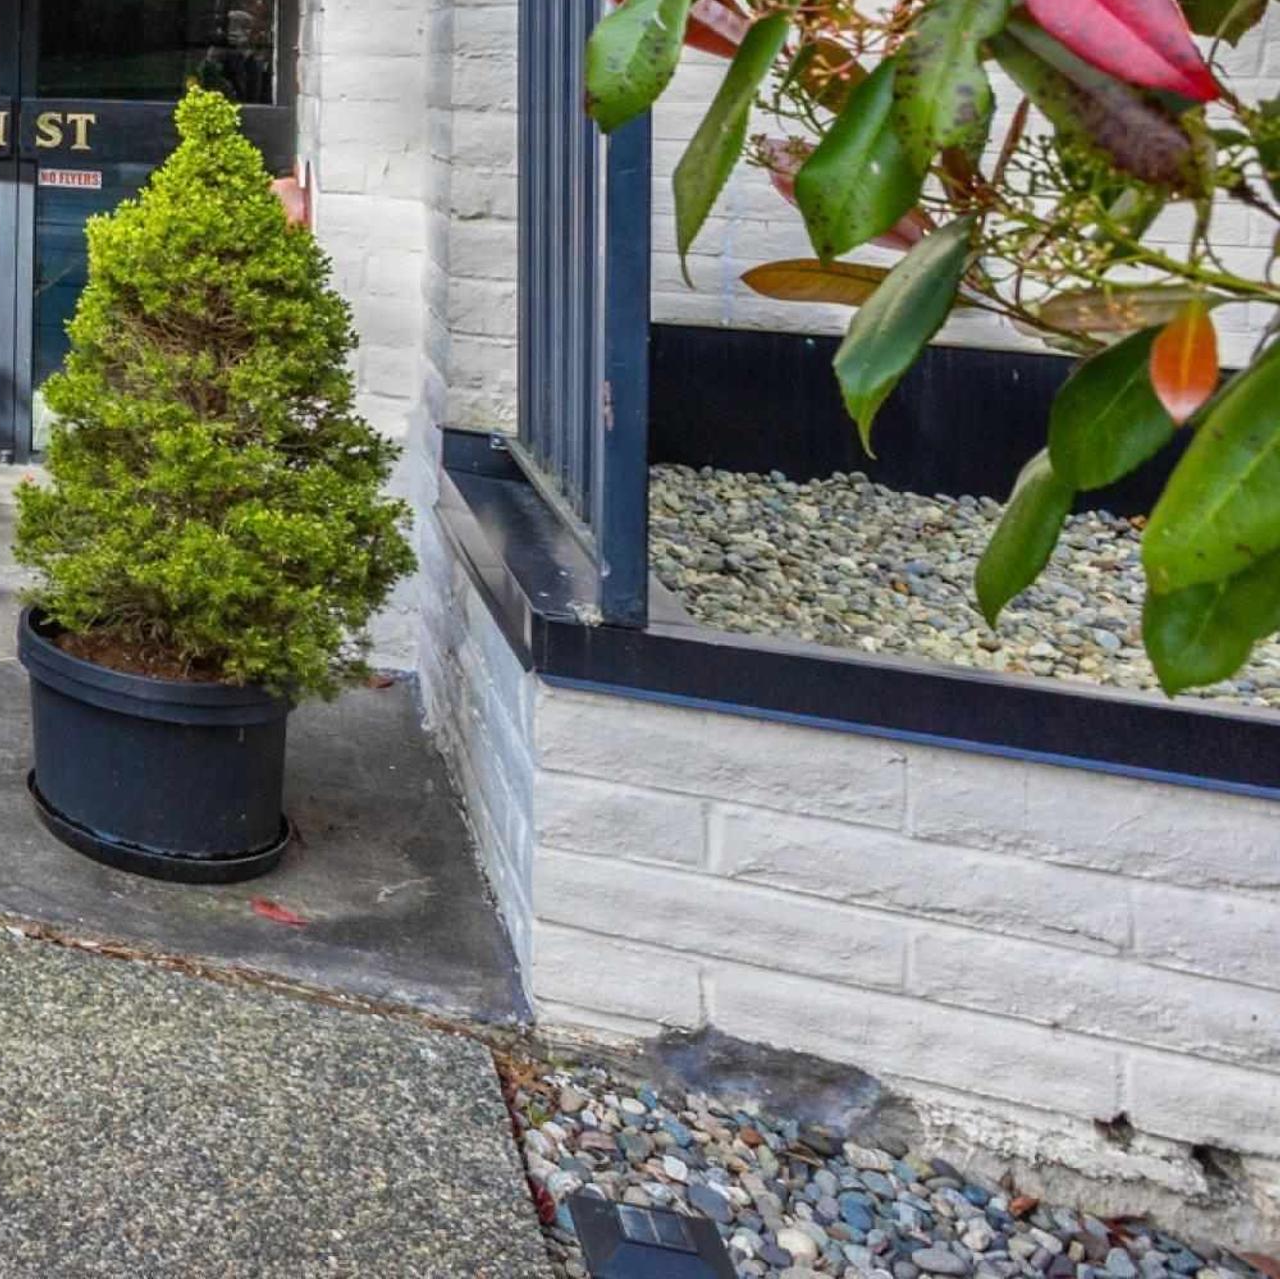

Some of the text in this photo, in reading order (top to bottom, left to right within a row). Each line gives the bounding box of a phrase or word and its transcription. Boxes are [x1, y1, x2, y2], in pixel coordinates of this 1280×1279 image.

[35, 111, 96, 150] ST
[41, 170, 99, 186] NO FLYERS
